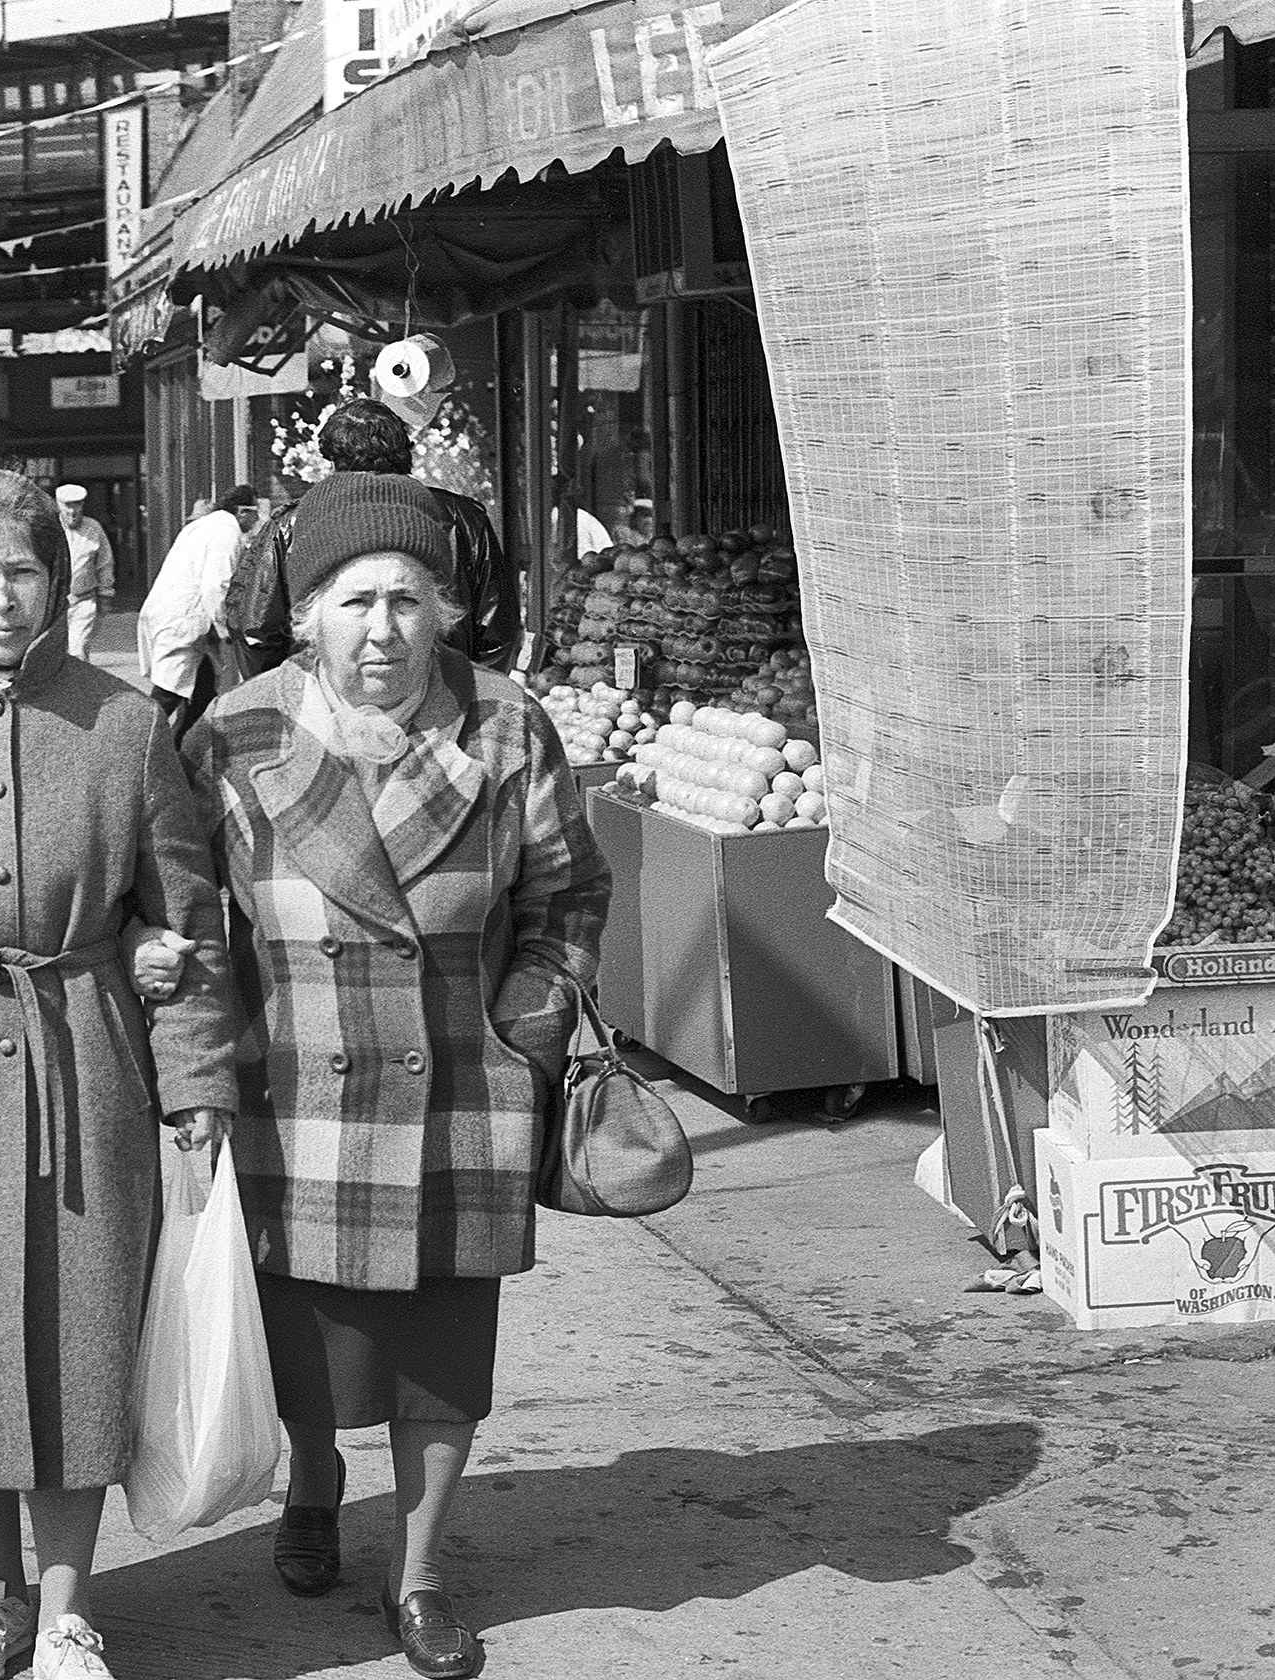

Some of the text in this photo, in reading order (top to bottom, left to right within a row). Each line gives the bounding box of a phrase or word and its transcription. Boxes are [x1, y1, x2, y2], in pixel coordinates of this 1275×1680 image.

[115, 118, 132, 261] RESTAURANT
[1185, 954, 1275, 977] Holland
[1112, 1170, 1275, 1237] FIRST FRU
[1175, 1282, 1274, 1315] WASHINGTON
[1189, 1287, 1208, 1301] OF
